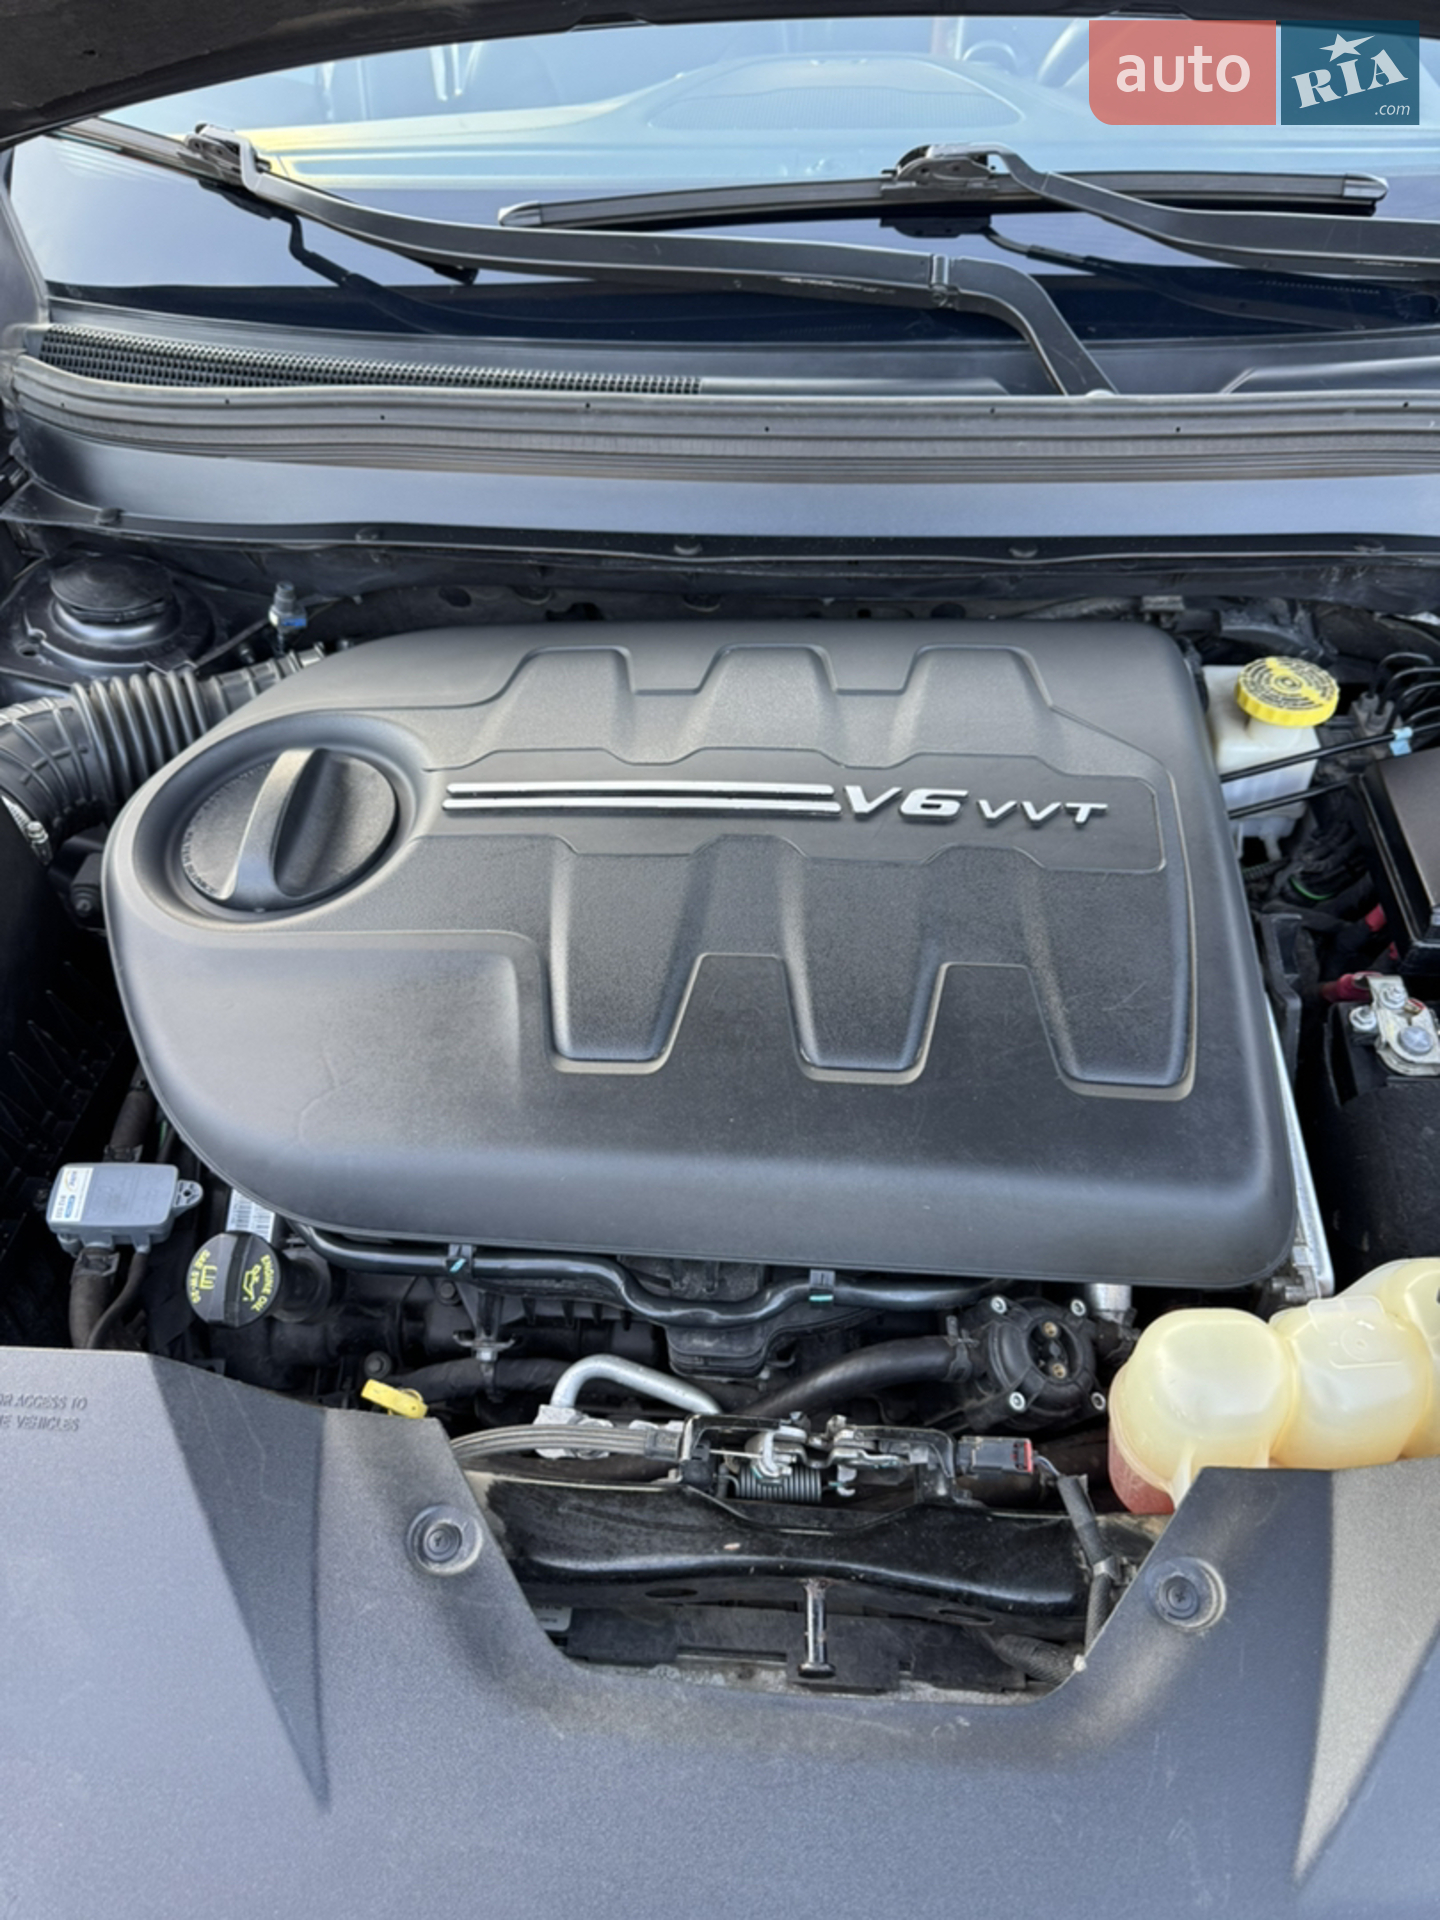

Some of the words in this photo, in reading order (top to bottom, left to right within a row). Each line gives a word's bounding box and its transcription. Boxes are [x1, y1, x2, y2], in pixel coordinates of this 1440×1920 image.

[844, 785, 969, 822] V6
[977, 799, 1108, 827] VVT
[261, 1254, 275, 1295] ENGINE
[251, 1295, 268, 1312] OIL
[14, 1394, 68, 1410] ACCESS
[71, 1396, 88, 1411] TO
[17, 1415, 80, 1432] VEHICLES
